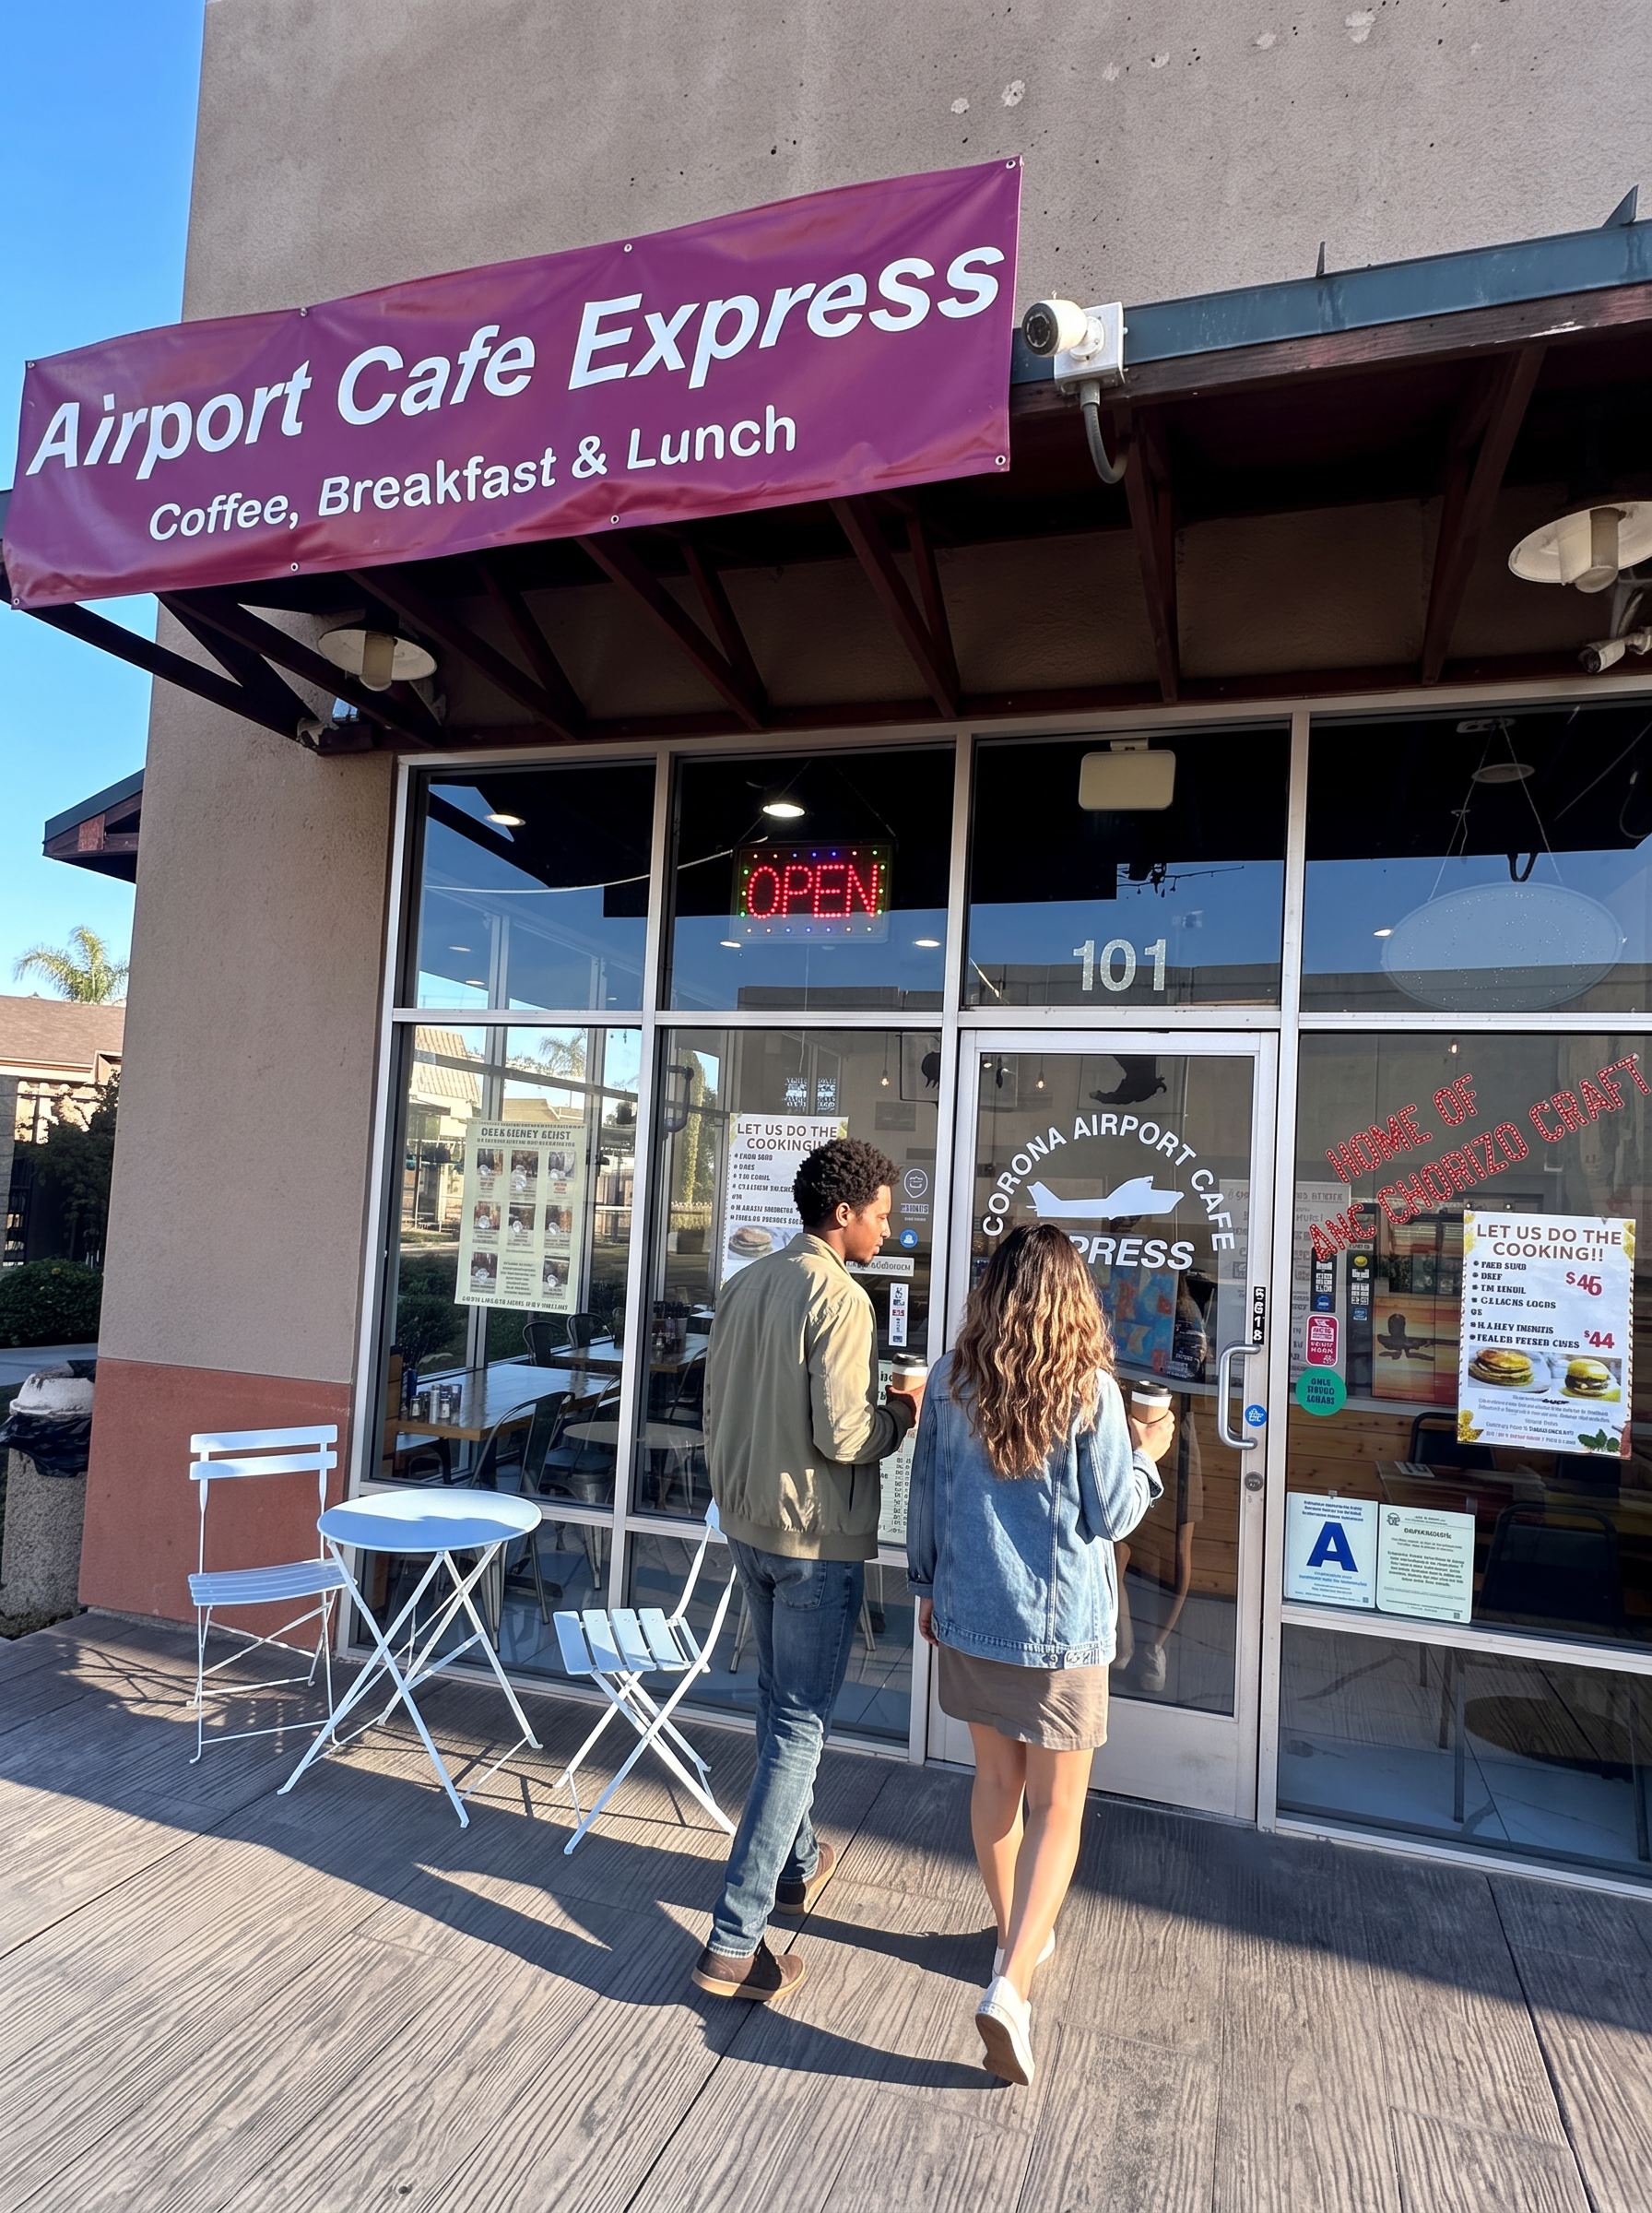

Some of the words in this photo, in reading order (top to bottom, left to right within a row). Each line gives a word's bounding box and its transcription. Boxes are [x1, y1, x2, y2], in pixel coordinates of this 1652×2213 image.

[26, 360, 312, 480] Airport
[337, 325, 536, 426] Cafe
[568, 246, 1006, 389] Express
[148, 491, 301, 540] Coffee,
[318, 447, 557, 516] Breakfast
[572, 435, 608, 479] &
[627, 405, 796, 470] Lunch
[746, 863, 879, 919] OPEN
[1072, 938, 1167, 992] 101
[738, 1123, 761, 1135] LET
[765, 1124, 783, 1136] US
[786, 1125, 807, 1137] DO
[810, 1126, 838, 1138] THE
[1325, 1104, 1433, 1184] HOME
[1433, 1073, 1478, 1127] OF
[1376, 1121, 1530, 1225] CHORIZO
[1528, 1052, 1652, 1142] CRAFT
[983, 1126, 1067, 1237] CORONA
[1073, 1113, 1197, 1166] AIRPORT
[1190, 1168, 1235, 1251] CAFE
[1068, 1235, 1196, 1271] PRESS
[1477, 1224, 1511, 1239] LET
[1516, 1225, 1541, 1241] US
[1548, 1227, 1577, 1243] DO
[1583, 1229, 1622, 1246] THE
[1493, 1241, 1604, 1262] COOKING!!
[1584, 1330, 1615, 1350] $44
[1305, 1521, 1359, 1573] A
